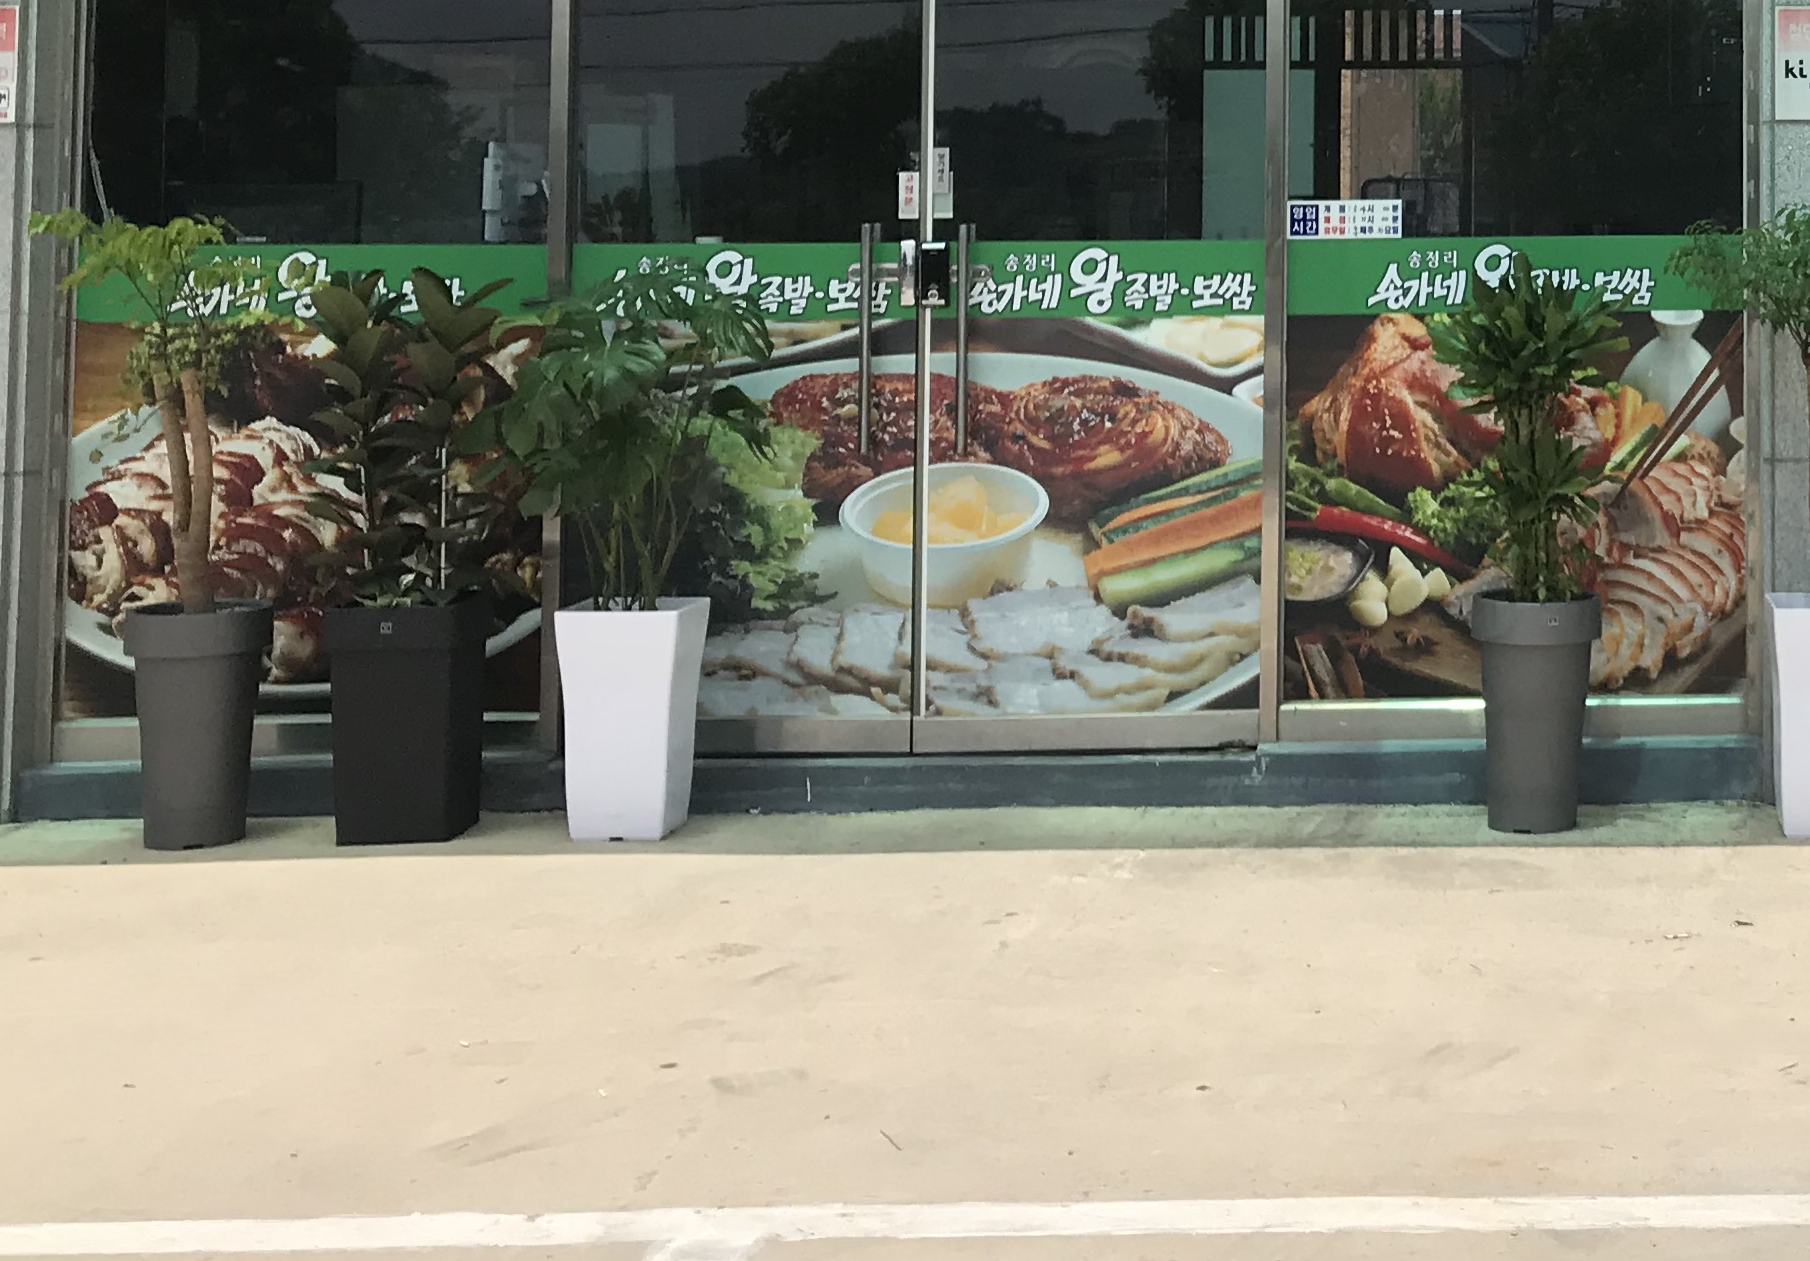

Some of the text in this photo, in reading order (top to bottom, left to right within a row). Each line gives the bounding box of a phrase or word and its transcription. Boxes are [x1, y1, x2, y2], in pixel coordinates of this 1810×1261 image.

[1004, 253, 1057, 272] 송정리
[1407, 250, 1458, 268] 송정리
[1367, 263, 1466, 310] 송가네
